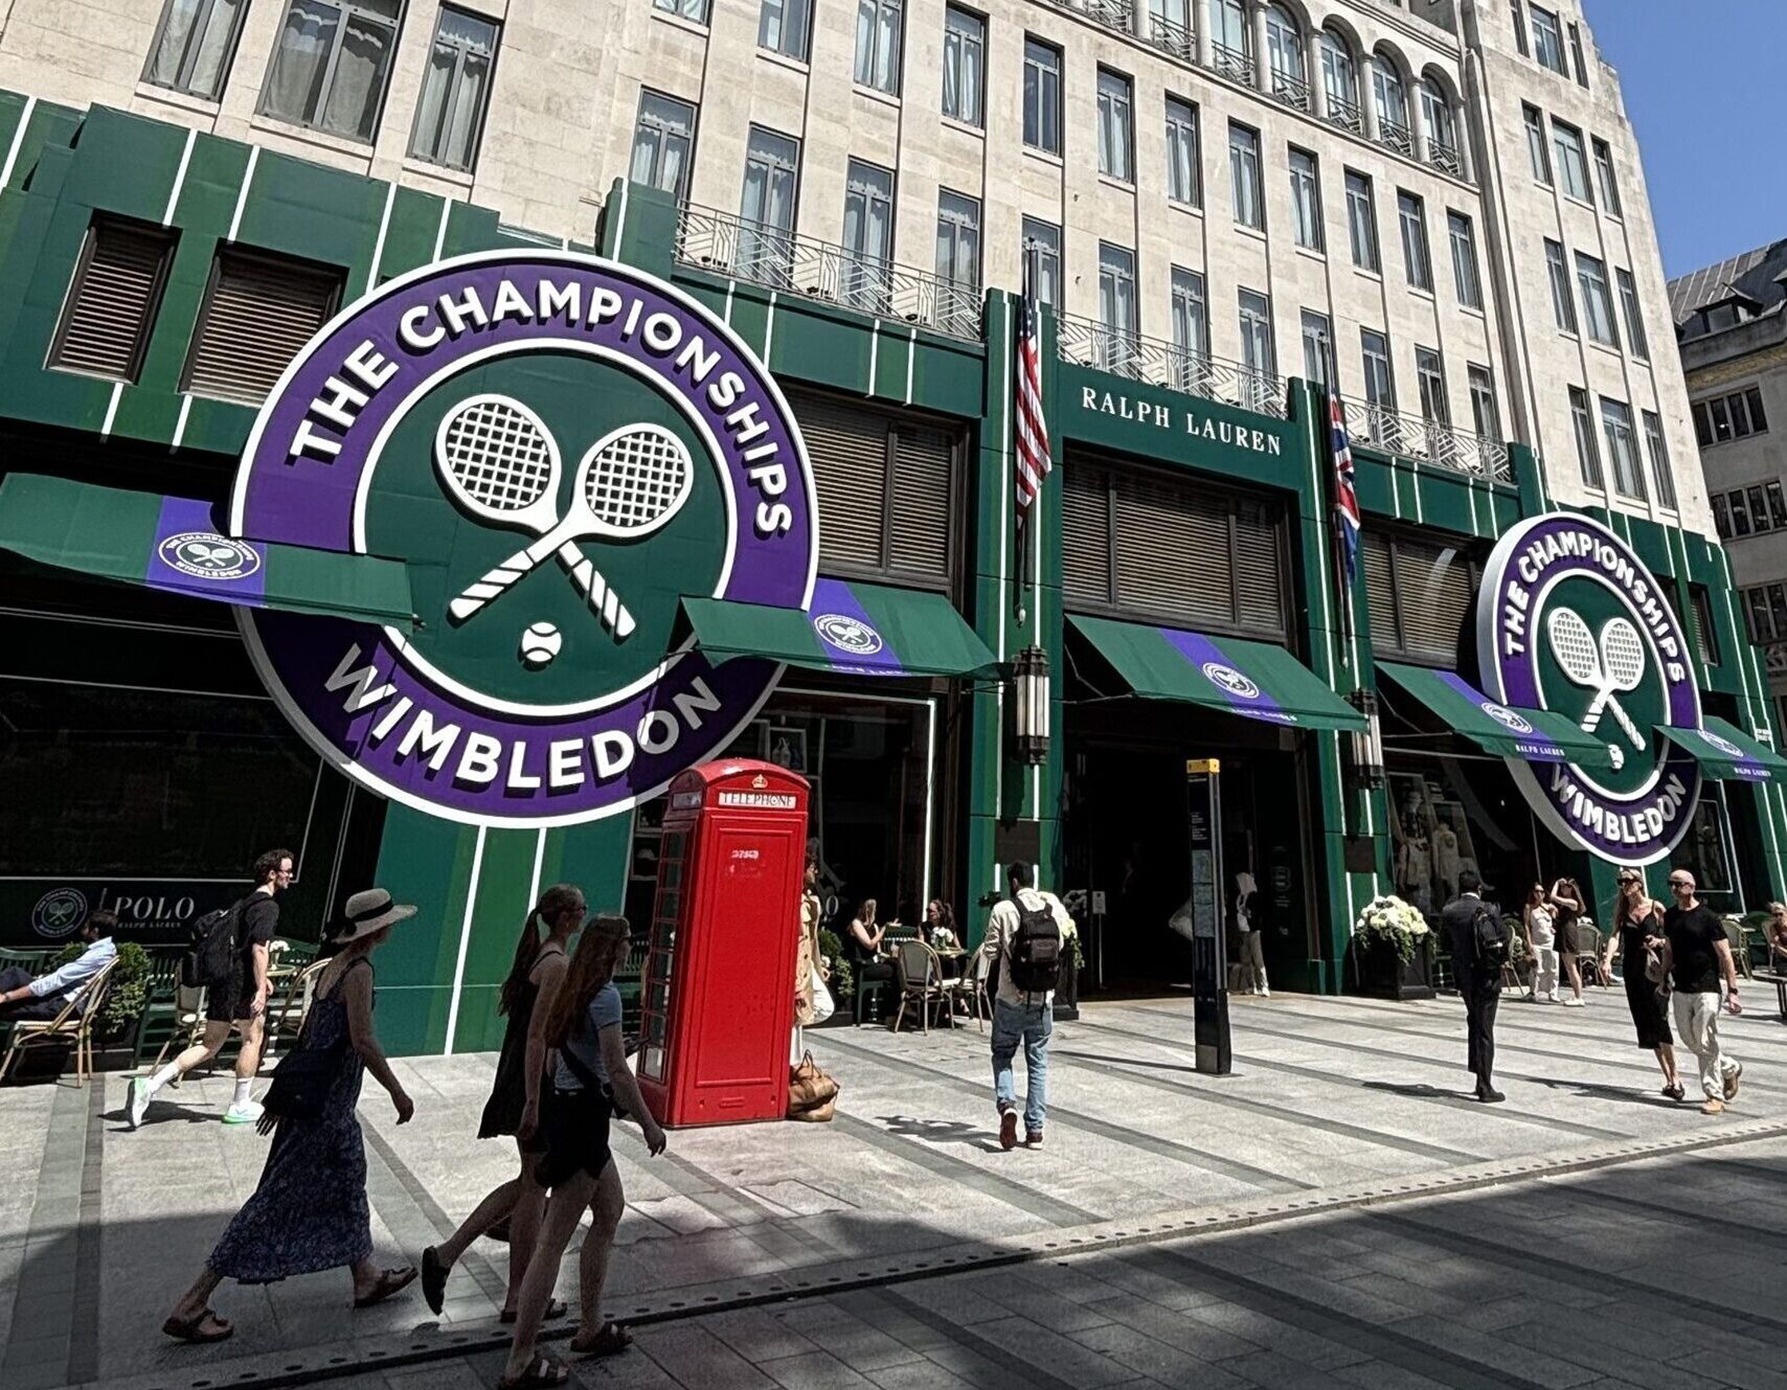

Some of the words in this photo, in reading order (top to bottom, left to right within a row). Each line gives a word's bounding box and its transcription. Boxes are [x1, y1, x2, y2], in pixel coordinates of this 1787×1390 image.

[295, 340, 398, 464] THE
[399, 279, 793, 532] CHAMPIONSHIPS
[1082, 386, 1170, 428] RALPH
[1186, 413, 1281, 456] LAUREN
[1504, 580, 1530, 655] THE
[1518, 531, 1685, 682] CHAMPIONSHIPS
[325, 643, 721, 789] WIMBLEDON
[1515, 744, 1538, 754] RALPH
[1540, 747, 1565, 756] LAUREN
[722, 792, 793, 806] TELEPHONE
[1551, 762, 1687, 843] WIMBLEDON
[114, 896, 195, 919] POLO
